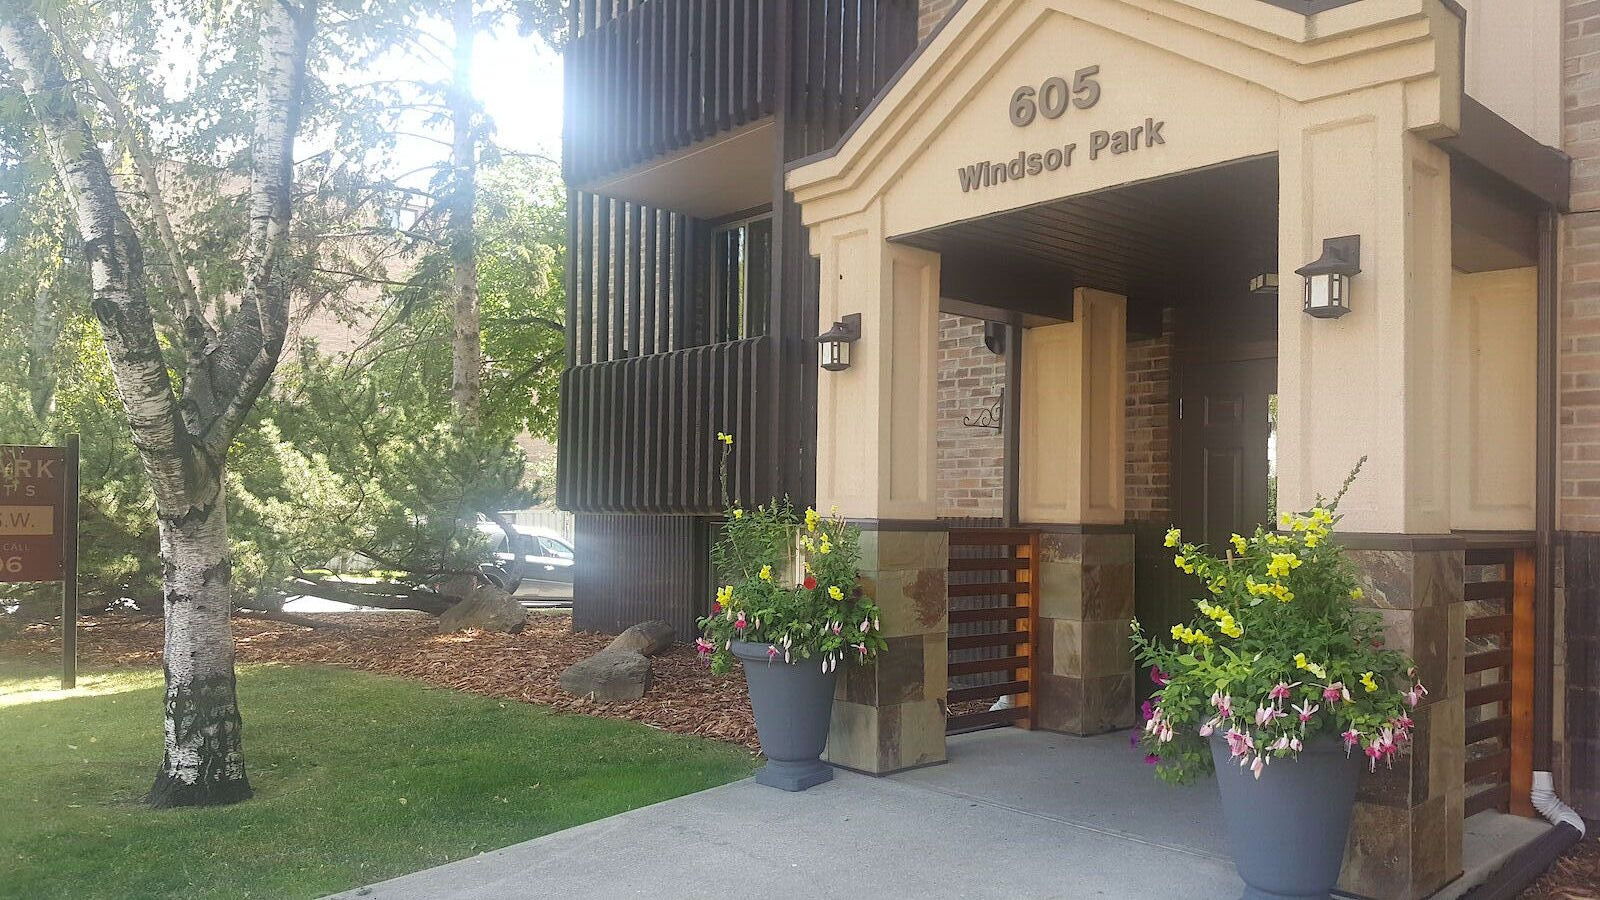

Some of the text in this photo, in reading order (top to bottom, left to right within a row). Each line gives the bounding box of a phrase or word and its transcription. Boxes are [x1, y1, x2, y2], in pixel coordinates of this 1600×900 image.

[1009, 64, 1101, 127] 605
[958, 118, 1166, 192] Windsor Park
[0, 512, 35, 528] .W.
